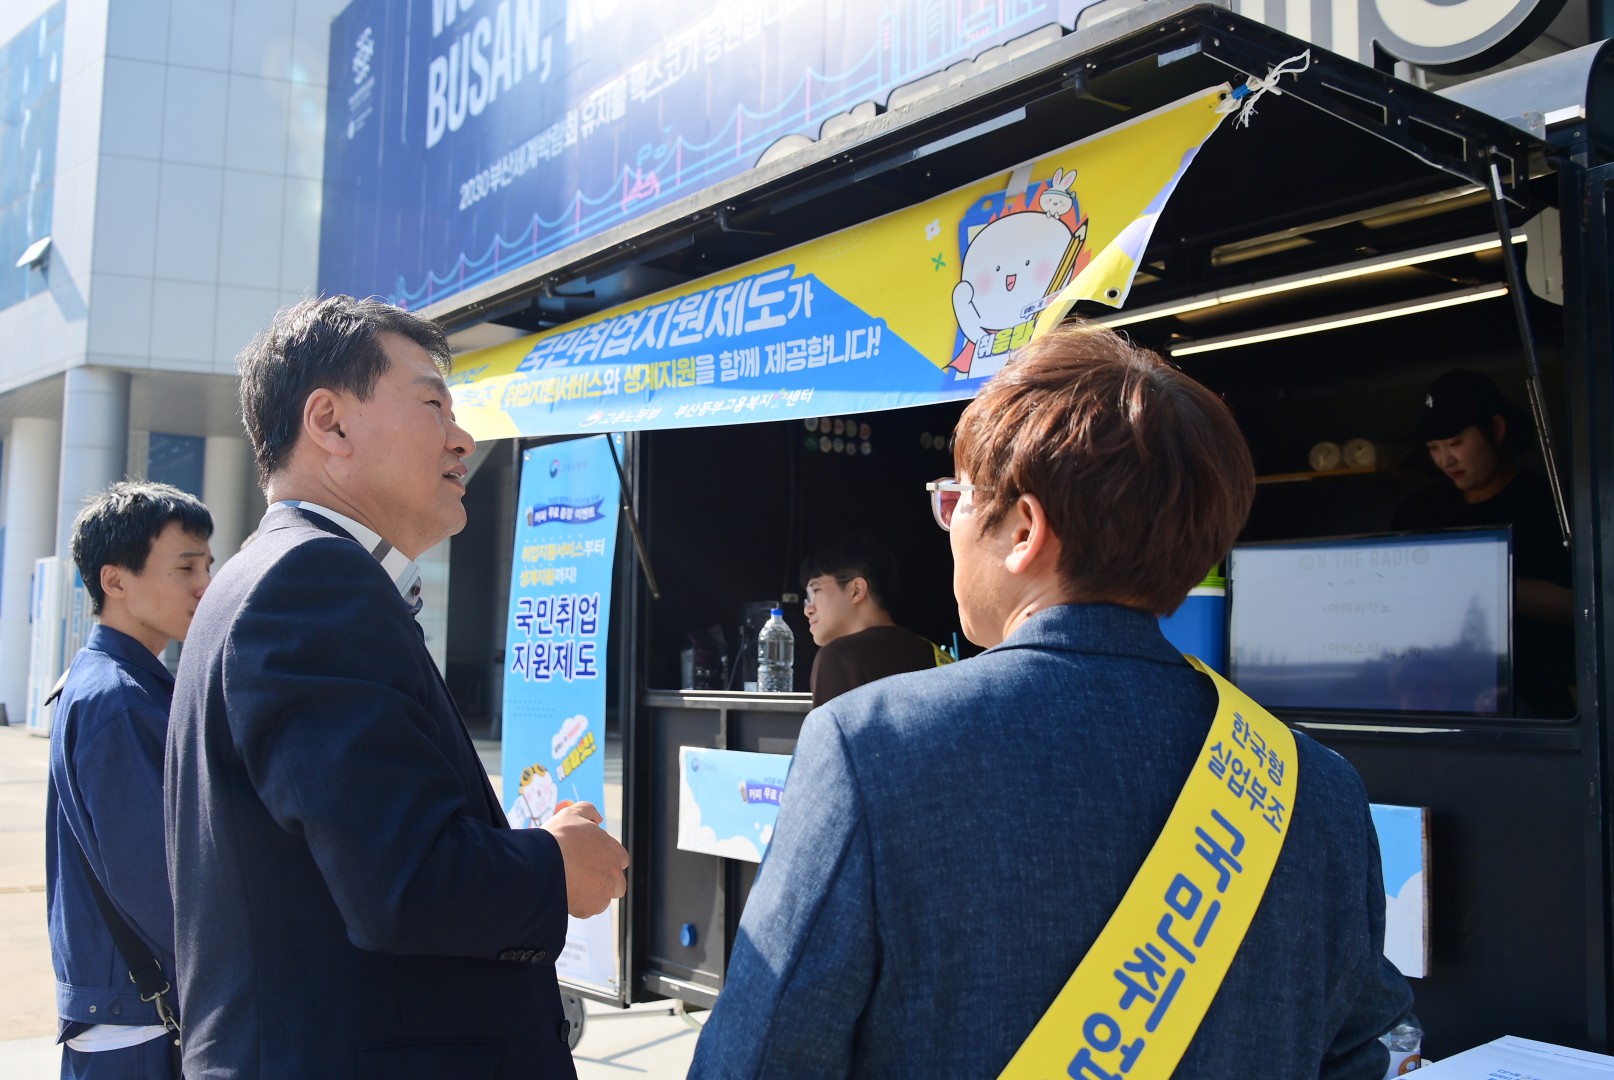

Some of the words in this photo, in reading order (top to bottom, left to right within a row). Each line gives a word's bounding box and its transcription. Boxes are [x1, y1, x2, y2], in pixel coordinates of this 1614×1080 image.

[426, 0, 552, 148] BUSAN,
[521, 269, 813, 372] 국민취업지원제도가
[504, 368, 621, 408] 취업지원서비스와
[623, 357, 715, 394] 생계지원을
[719, 349, 760, 382] 함께
[765, 326, 882, 374] 제공합니다!
[1299, 554, 1327, 571] ON
[1333, 551, 1363, 569] THE
[1370, 547, 1431, 568] RADIO
[515, 594, 599, 636] 국민취업
[512, 641, 597, 681] 지원제도
[1208, 741, 1286, 834] 실업부조
[1232, 710, 1285, 787] 한국형
